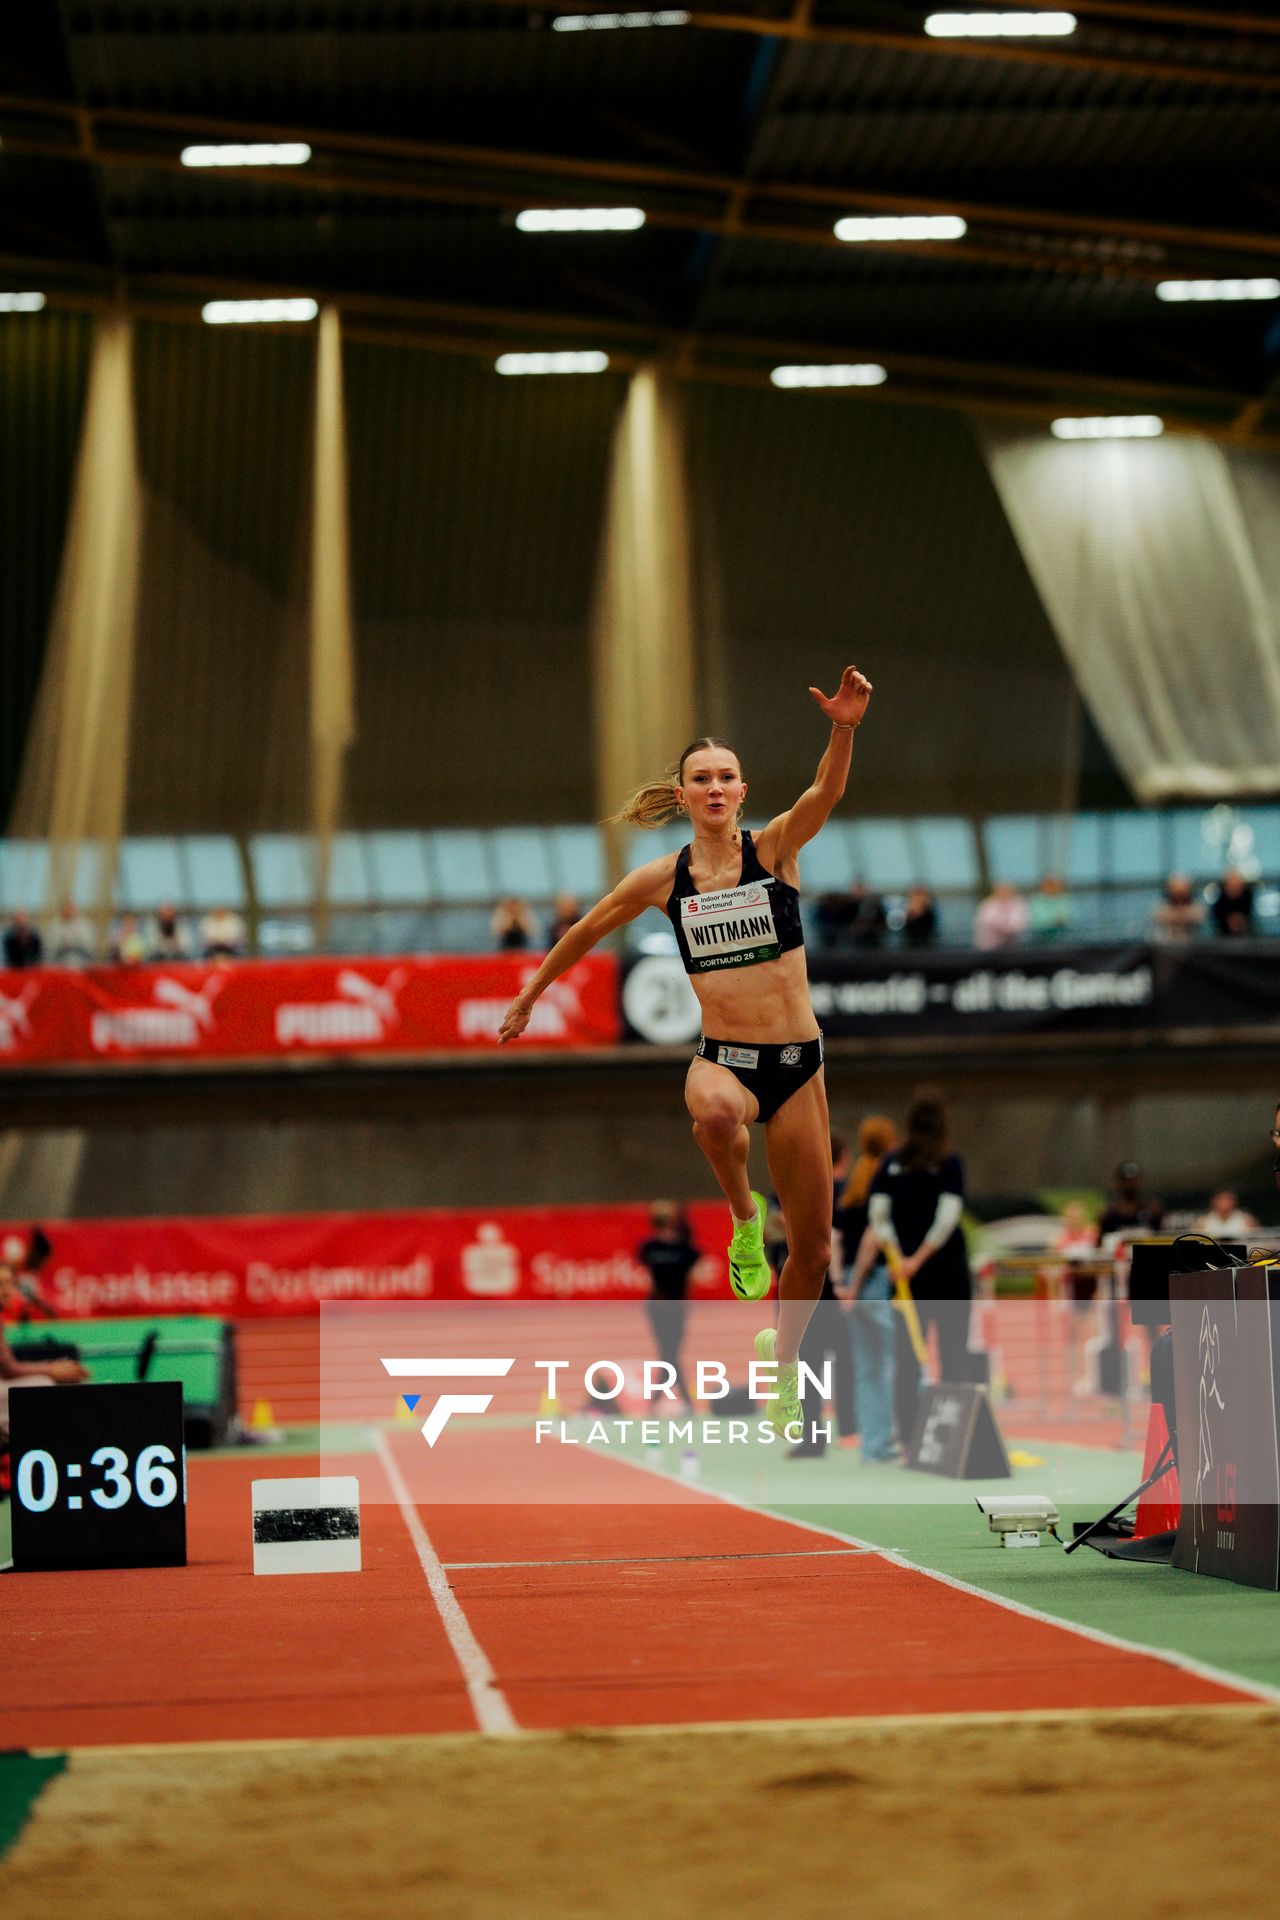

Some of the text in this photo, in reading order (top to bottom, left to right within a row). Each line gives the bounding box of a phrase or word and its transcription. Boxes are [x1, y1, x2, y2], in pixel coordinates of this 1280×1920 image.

[701, 890, 746, 903] Indoor Meeting
[701, 901, 733, 911] Dortmund
[691, 915, 772, 946] WITTMANN
[700, 955, 743, 968] DORTMUND
[743, 952, 755, 960] 26
[781, 1046, 800, 1064] 96
[17, 1445, 178, 1512] 0:36
